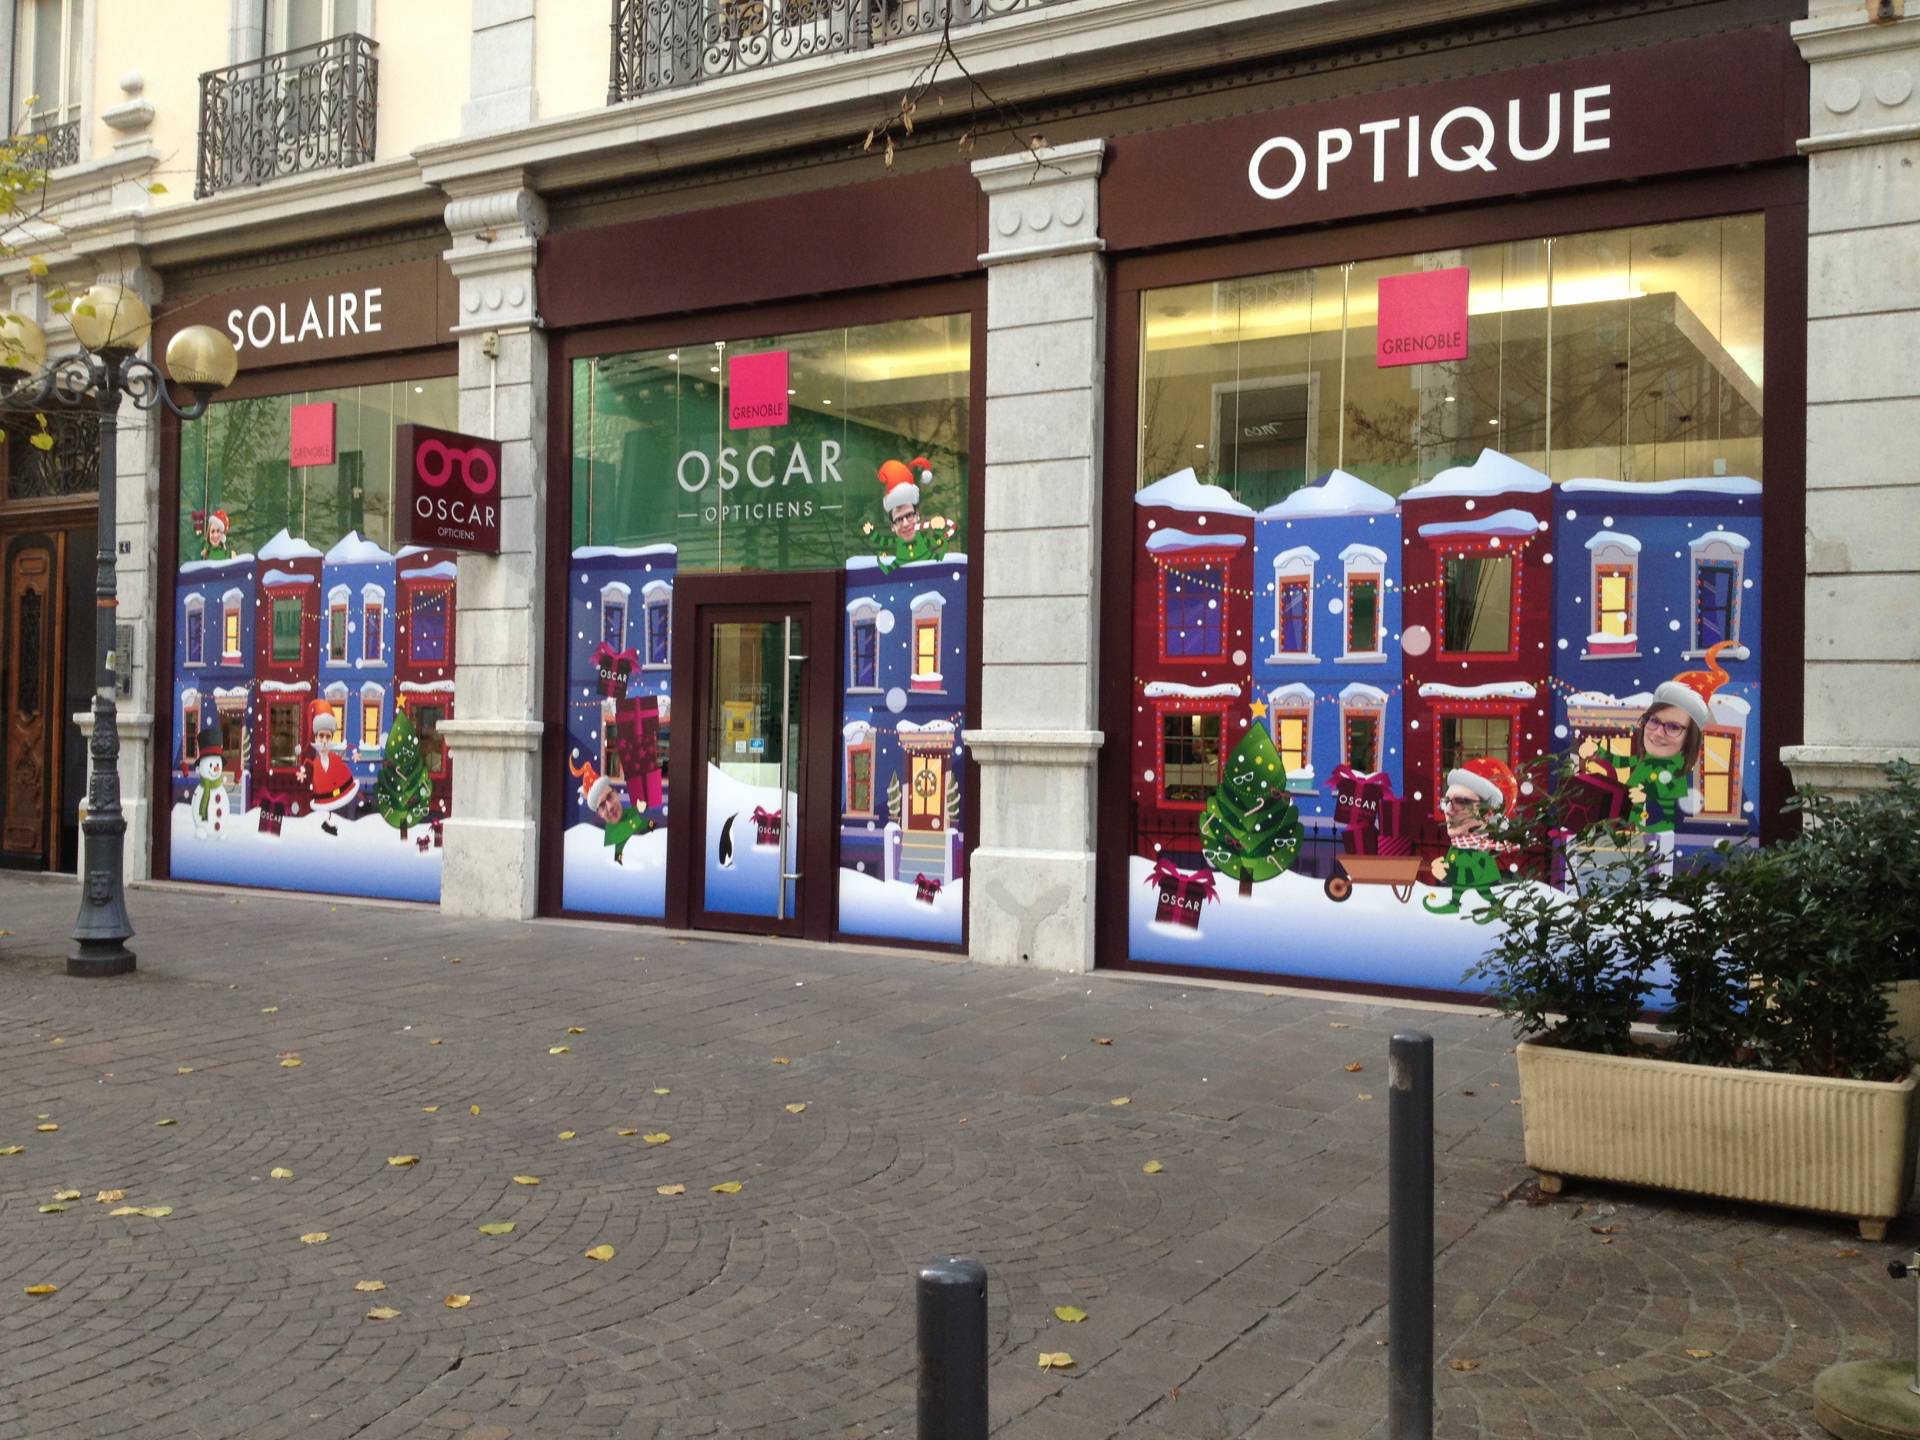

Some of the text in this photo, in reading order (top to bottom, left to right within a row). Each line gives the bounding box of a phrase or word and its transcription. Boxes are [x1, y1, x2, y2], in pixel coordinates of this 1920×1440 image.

[1248, 84, 1611, 200] OPTIQUE
[227, 287, 382, 352] SOLAIRE
[1382, 332, 1461, 355] GRENOBLE
[733, 402, 783, 420] GRENOBLE
[677, 440, 843, 493] OSCAR
[416, 495, 496, 528] OSCAR
[704, 500, 813, 522] OPTICIENS
[437, 526, 475, 541] OPTICIENS
[600, 669, 628, 683] OSCAR
[1339, 794, 1377, 811] OSCAR
[260, 810, 283, 823] OSCAR
[1160, 892, 1200, 912] OSCAR
